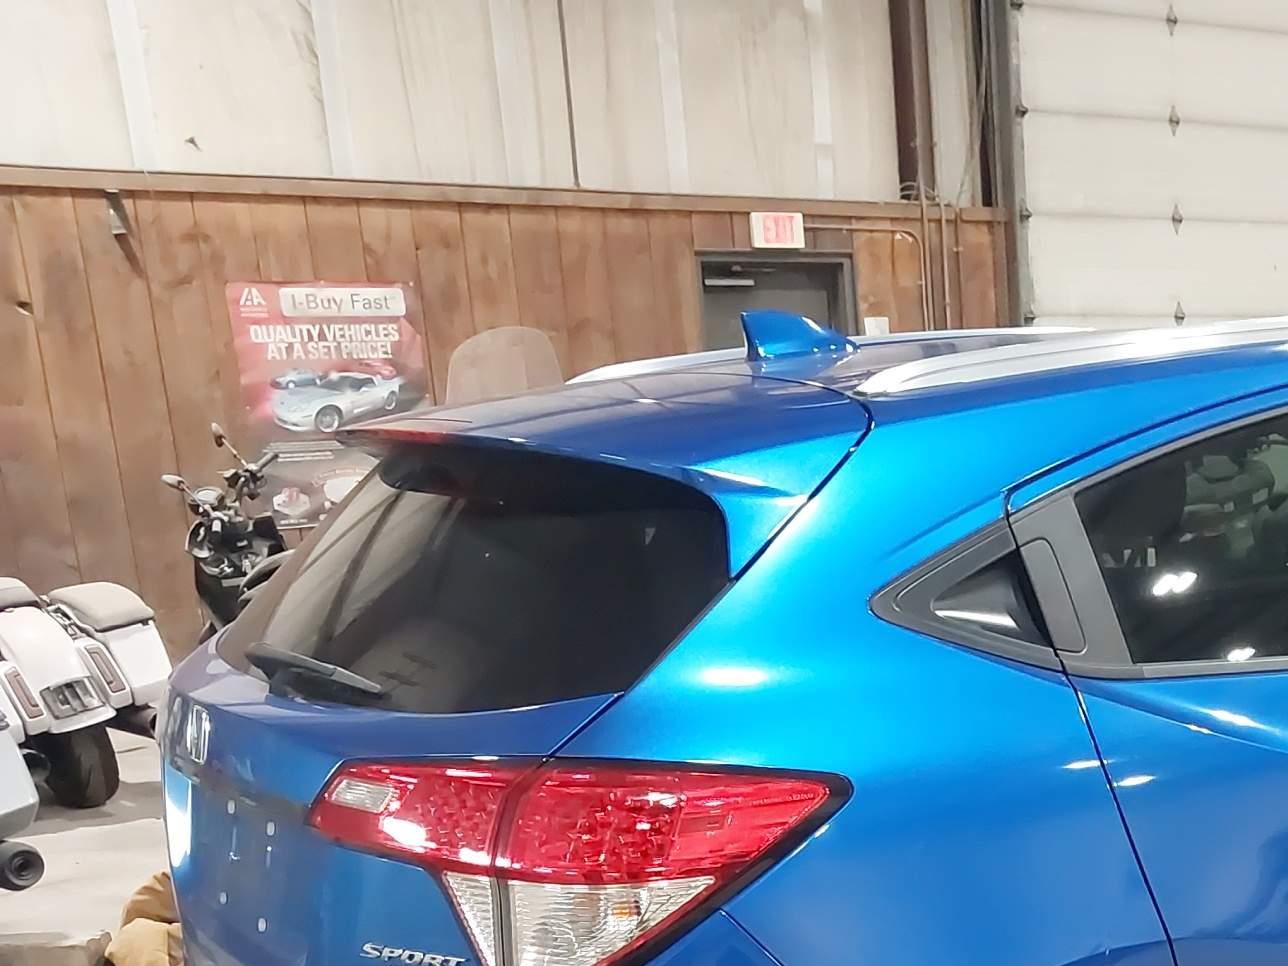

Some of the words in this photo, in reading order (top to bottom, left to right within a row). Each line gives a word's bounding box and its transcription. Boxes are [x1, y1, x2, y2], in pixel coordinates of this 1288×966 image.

[763, 215, 795, 244] EXIT
[291, 293, 344, 313] I-Buy
[250, 323, 320, 343] QUALITY
[322, 323, 400, 342] VEHICLES
[266, 343, 289, 360] AT
[292, 342, 306, 360] A
[308, 342, 338, 360] SET
[341, 341, 393, 358] PRICE!
